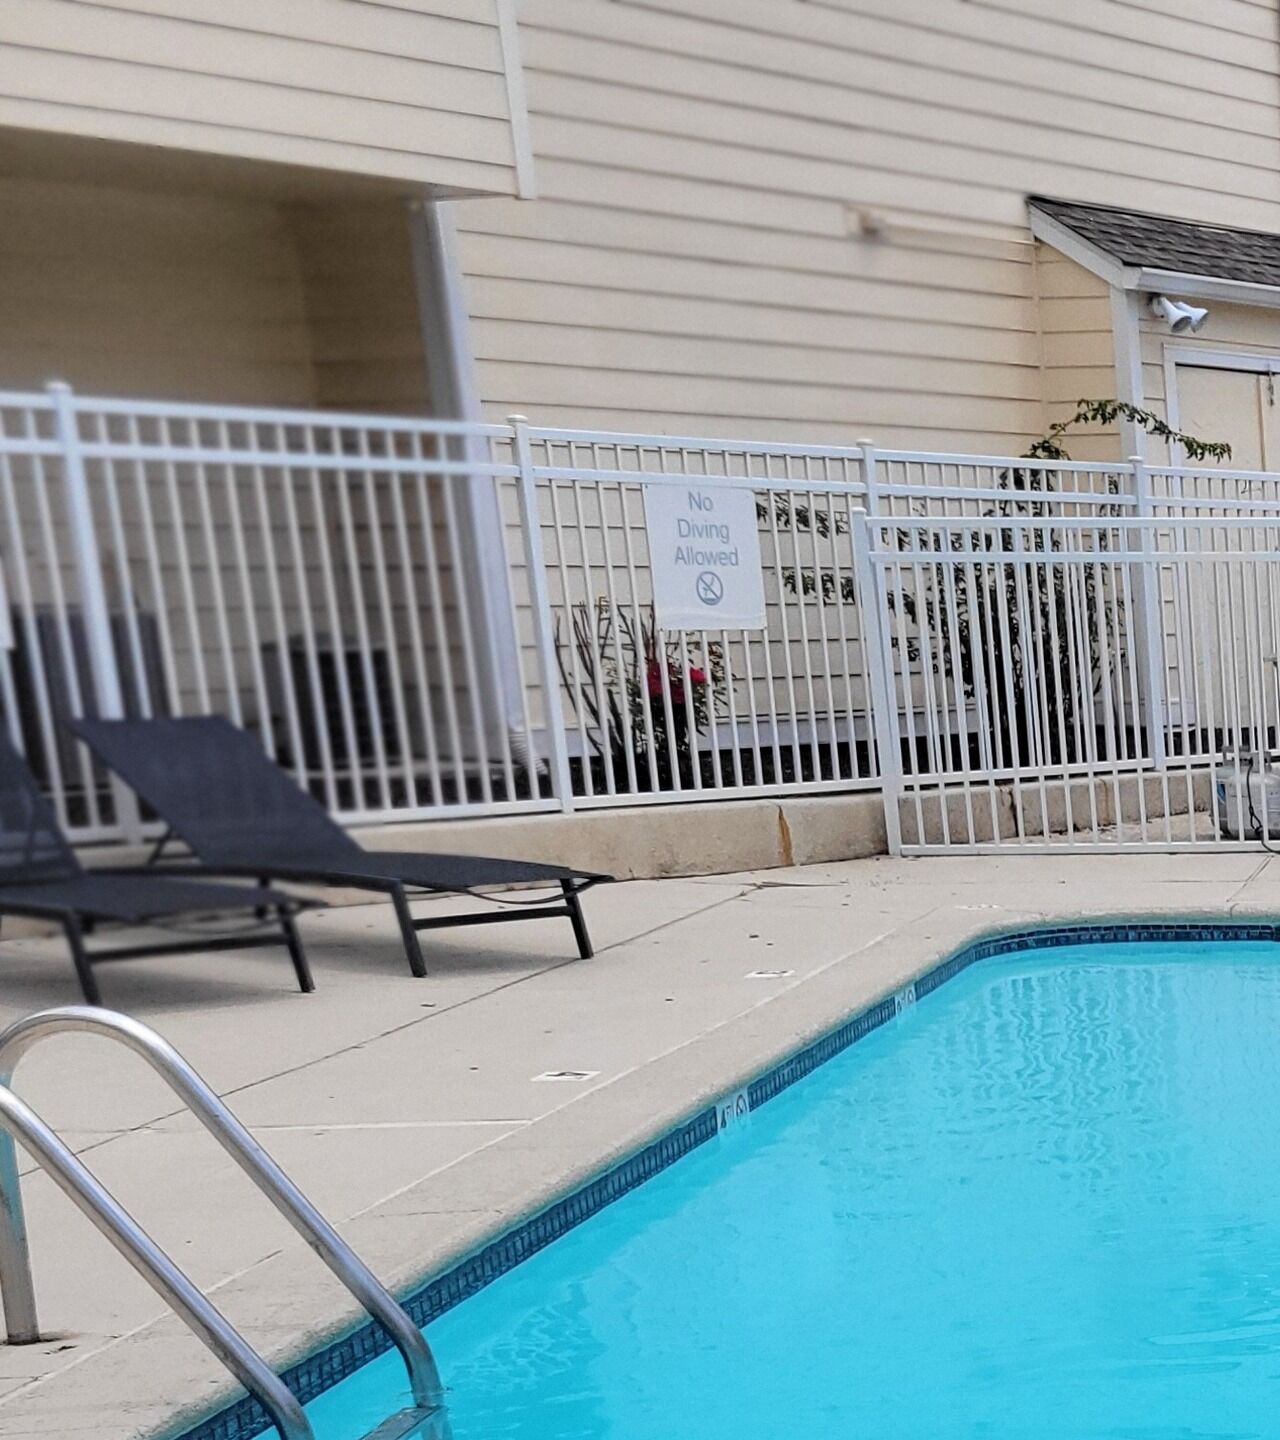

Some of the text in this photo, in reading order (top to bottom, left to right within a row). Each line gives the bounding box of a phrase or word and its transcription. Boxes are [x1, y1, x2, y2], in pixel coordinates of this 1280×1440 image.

[687, 490, 714, 512] No
[676, 518, 730, 544] Diving
[674, 546, 740, 566] Allowed
